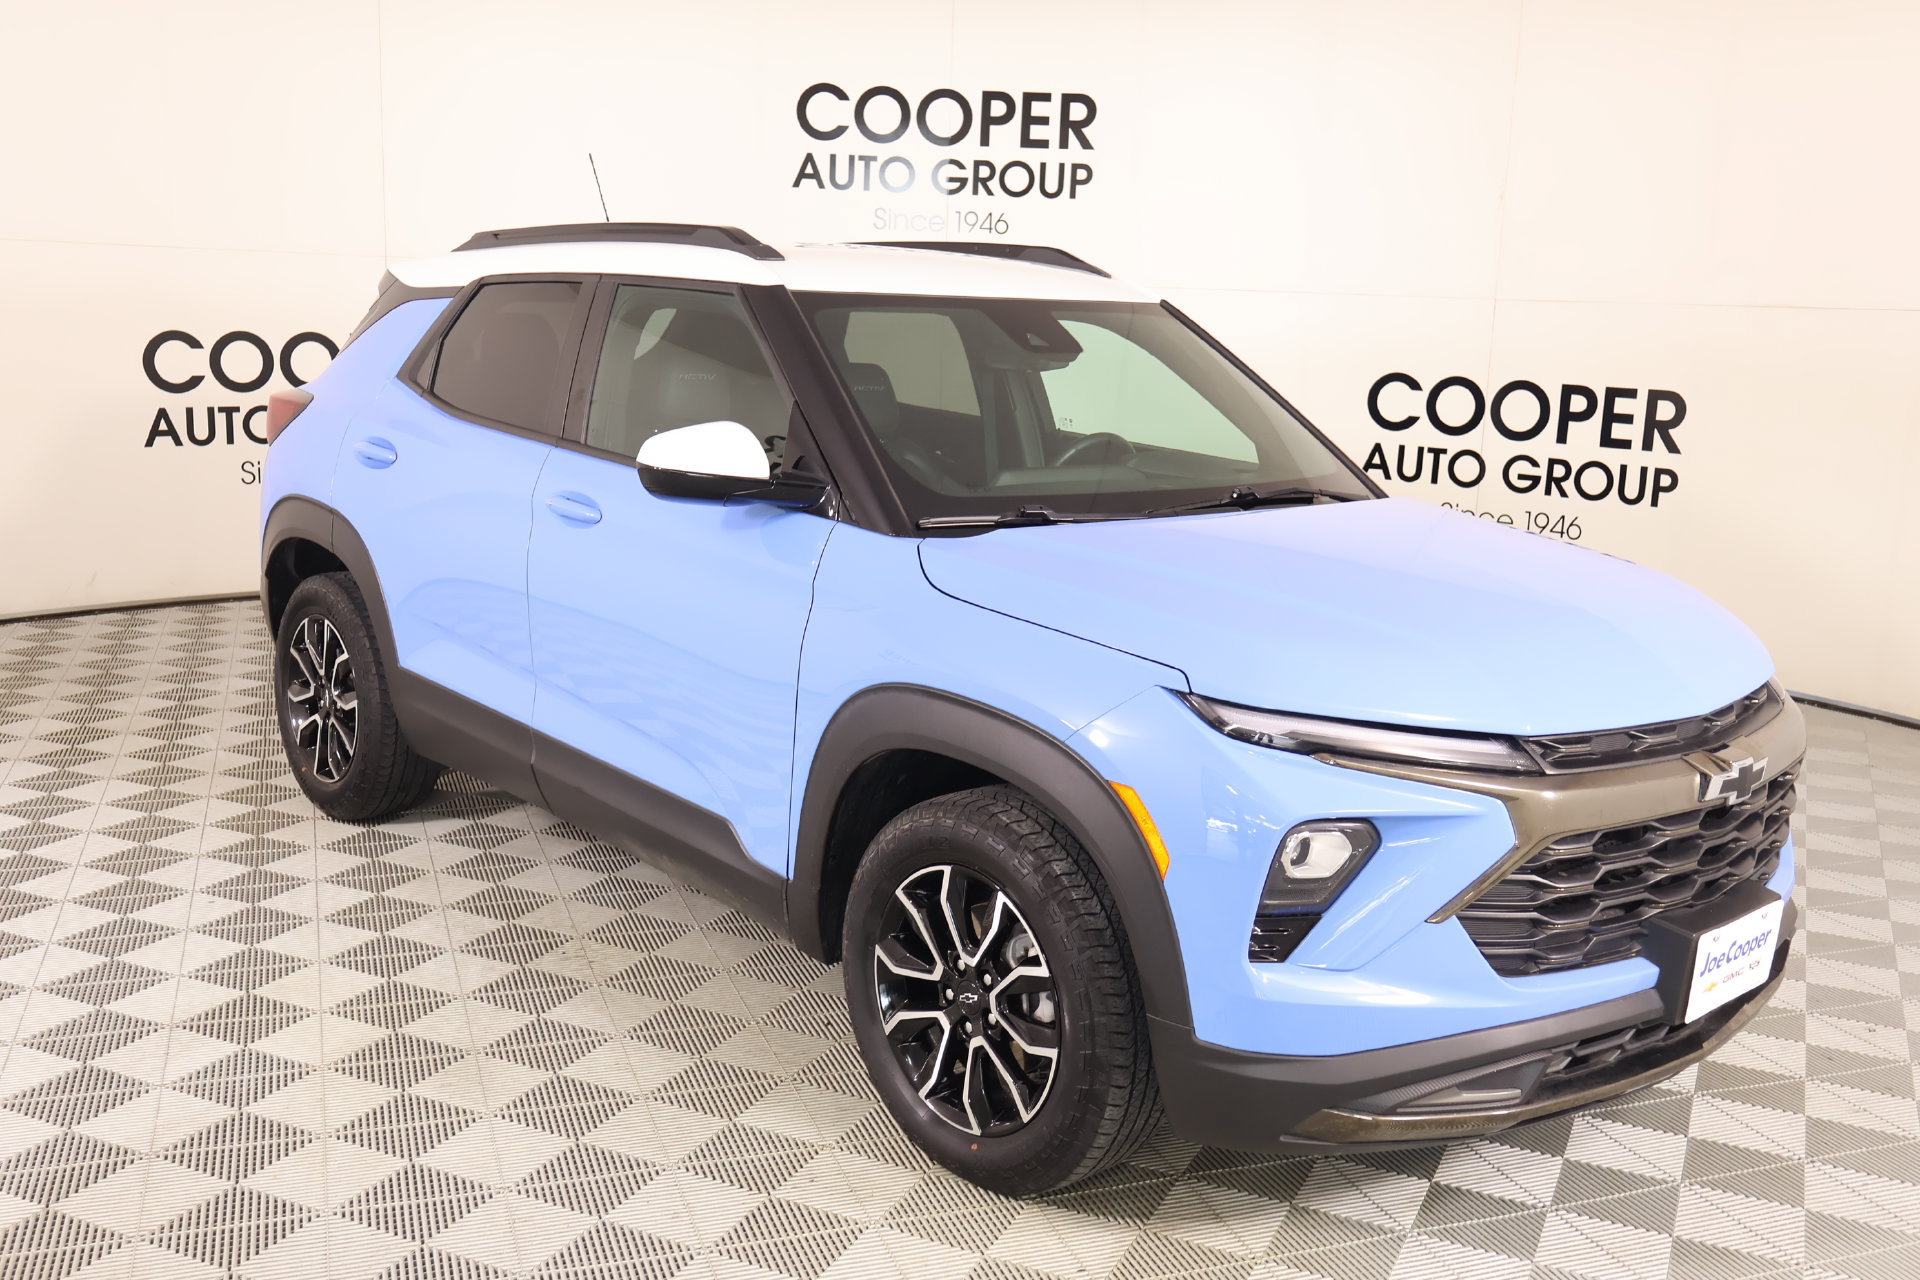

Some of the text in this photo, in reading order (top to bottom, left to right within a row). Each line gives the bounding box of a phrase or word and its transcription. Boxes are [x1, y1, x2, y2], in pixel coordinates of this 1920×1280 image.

[796, 83, 1098, 150] COOPER
[792, 152, 1093, 199] AUTO GROUP
[873, 207, 1009, 234] Since 1946
[142, 329, 340, 394] COO
[1367, 372, 1687, 455] COOPER
[1363, 442, 1679, 508] AUTO GROUP
[1525, 511, 1582, 540] 1946
[1723, 967, 1745, 983] GMC
